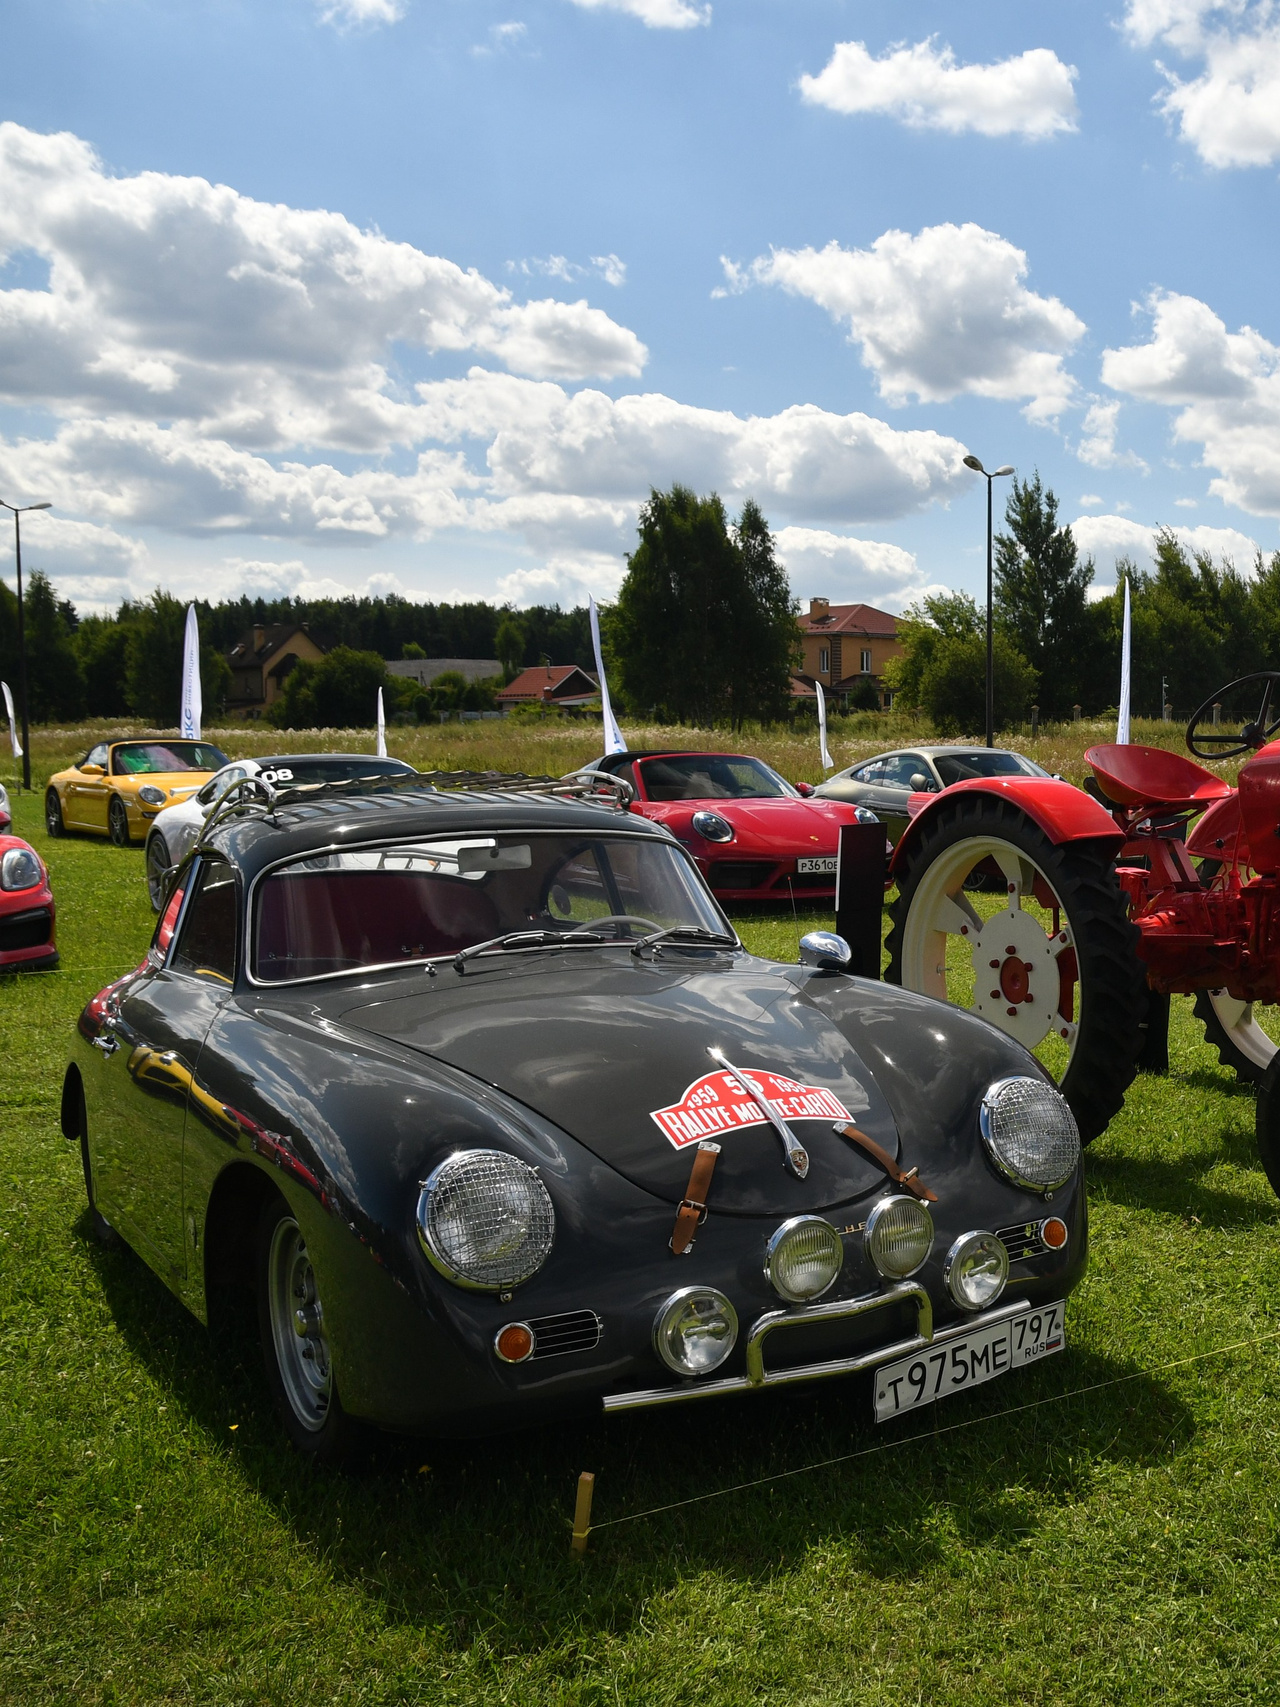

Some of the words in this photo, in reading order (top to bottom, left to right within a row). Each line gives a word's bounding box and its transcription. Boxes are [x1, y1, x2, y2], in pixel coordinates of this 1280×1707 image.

[261, 768, 294, 784] 08
[686, 1084, 720, 1109] 1959
[660, 1105, 737, 1142] RALLYE
[731, 1090, 847, 1122] MOTE-CARLO
[887, 1336, 1008, 1410] T975ME
[1014, 1308, 1058, 1350] 797
[1024, 1342, 1045, 1359] RUS
